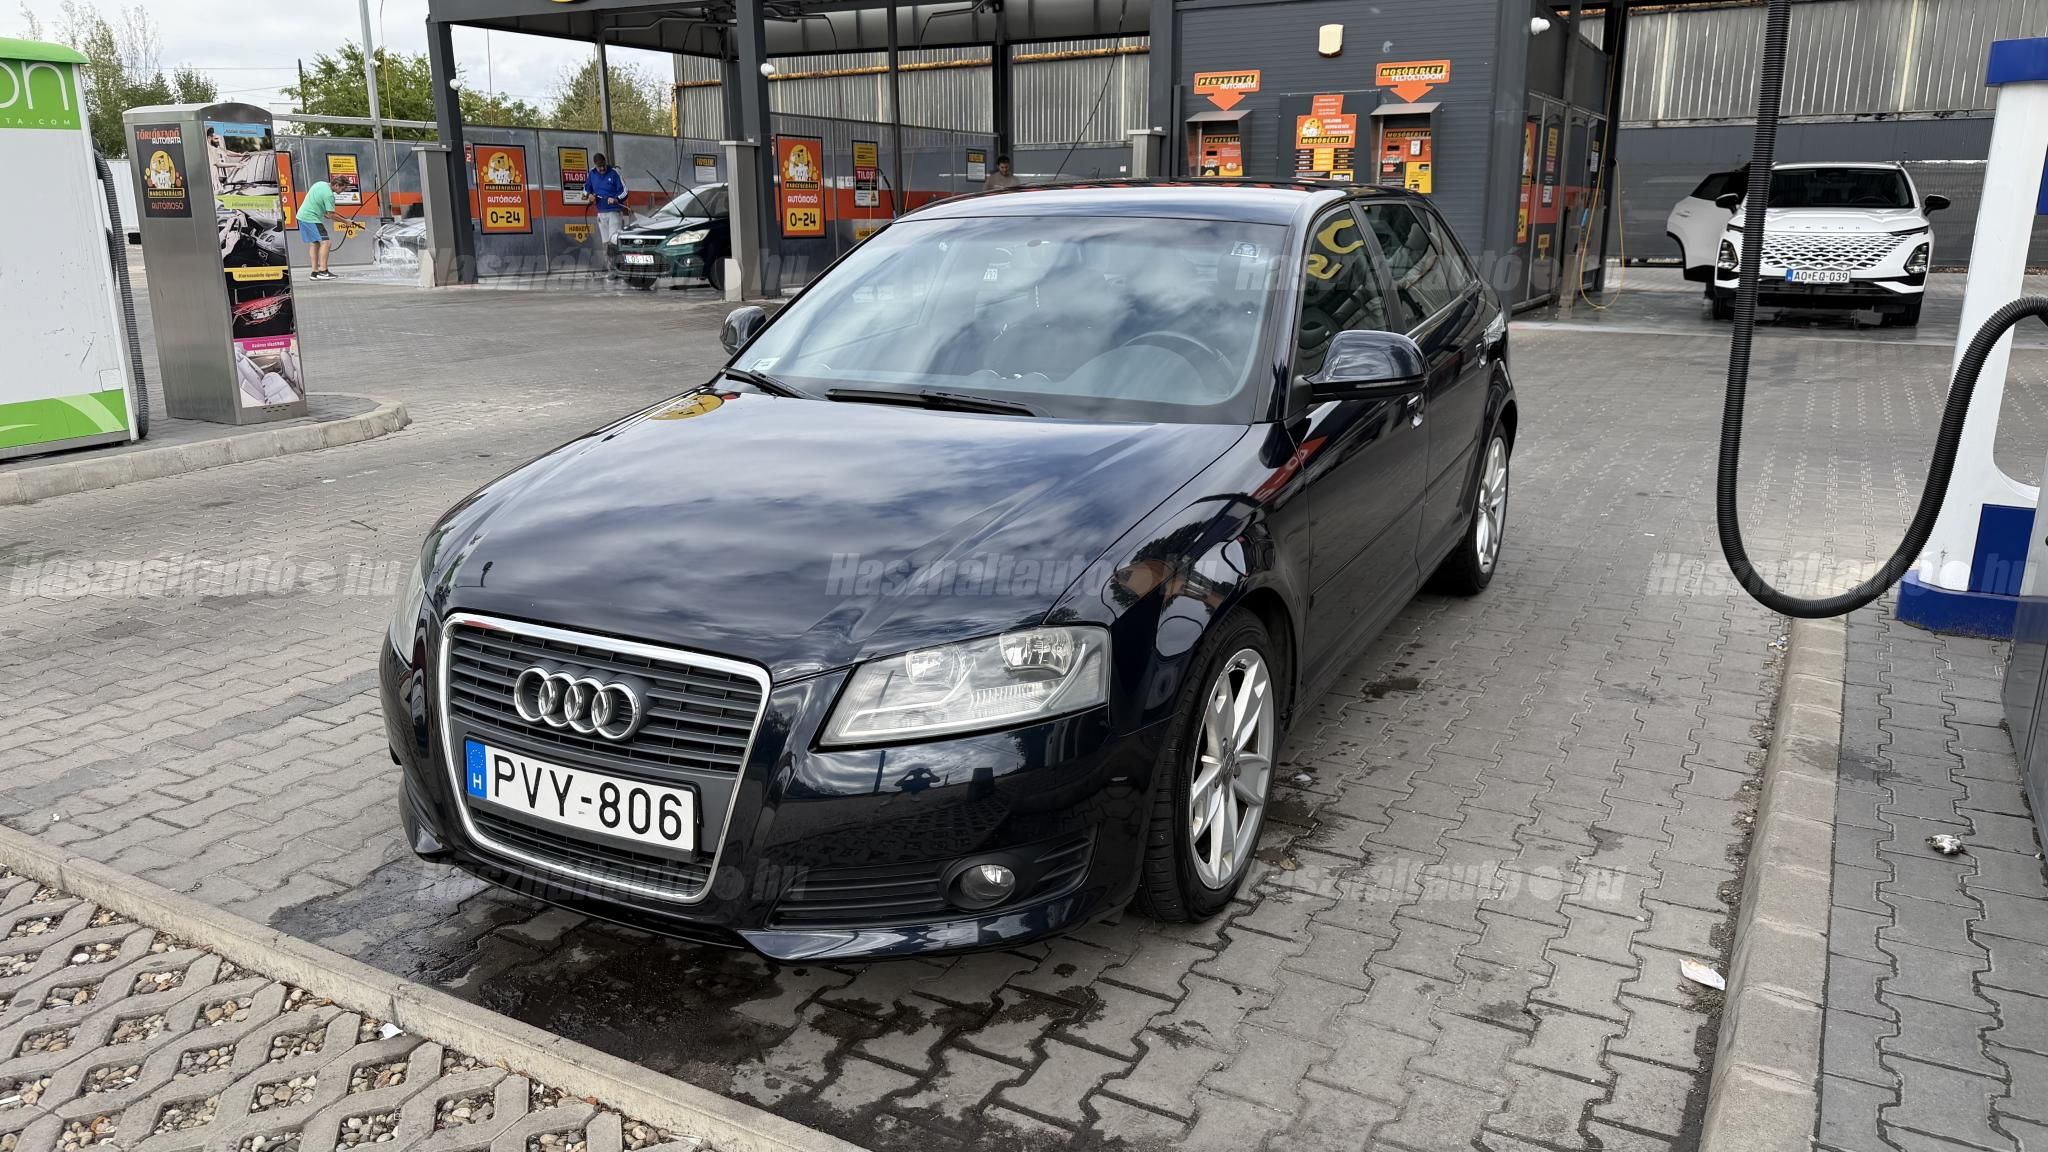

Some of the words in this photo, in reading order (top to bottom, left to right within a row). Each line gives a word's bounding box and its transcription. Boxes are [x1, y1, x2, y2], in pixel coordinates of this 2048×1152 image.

[1382, 66, 1442, 76] MOSÓBÉRLET
[487, 194, 522, 203] AUTÓMOSÓ
[788, 193, 818, 203] AUTÓMOSÓ
[151, 200, 184, 209] AUTÓMOSÓ
[490, 211, 521, 224] 0-24
[789, 212, 817, 227] 0-24
[493, 753, 683, 842] PVY-806
